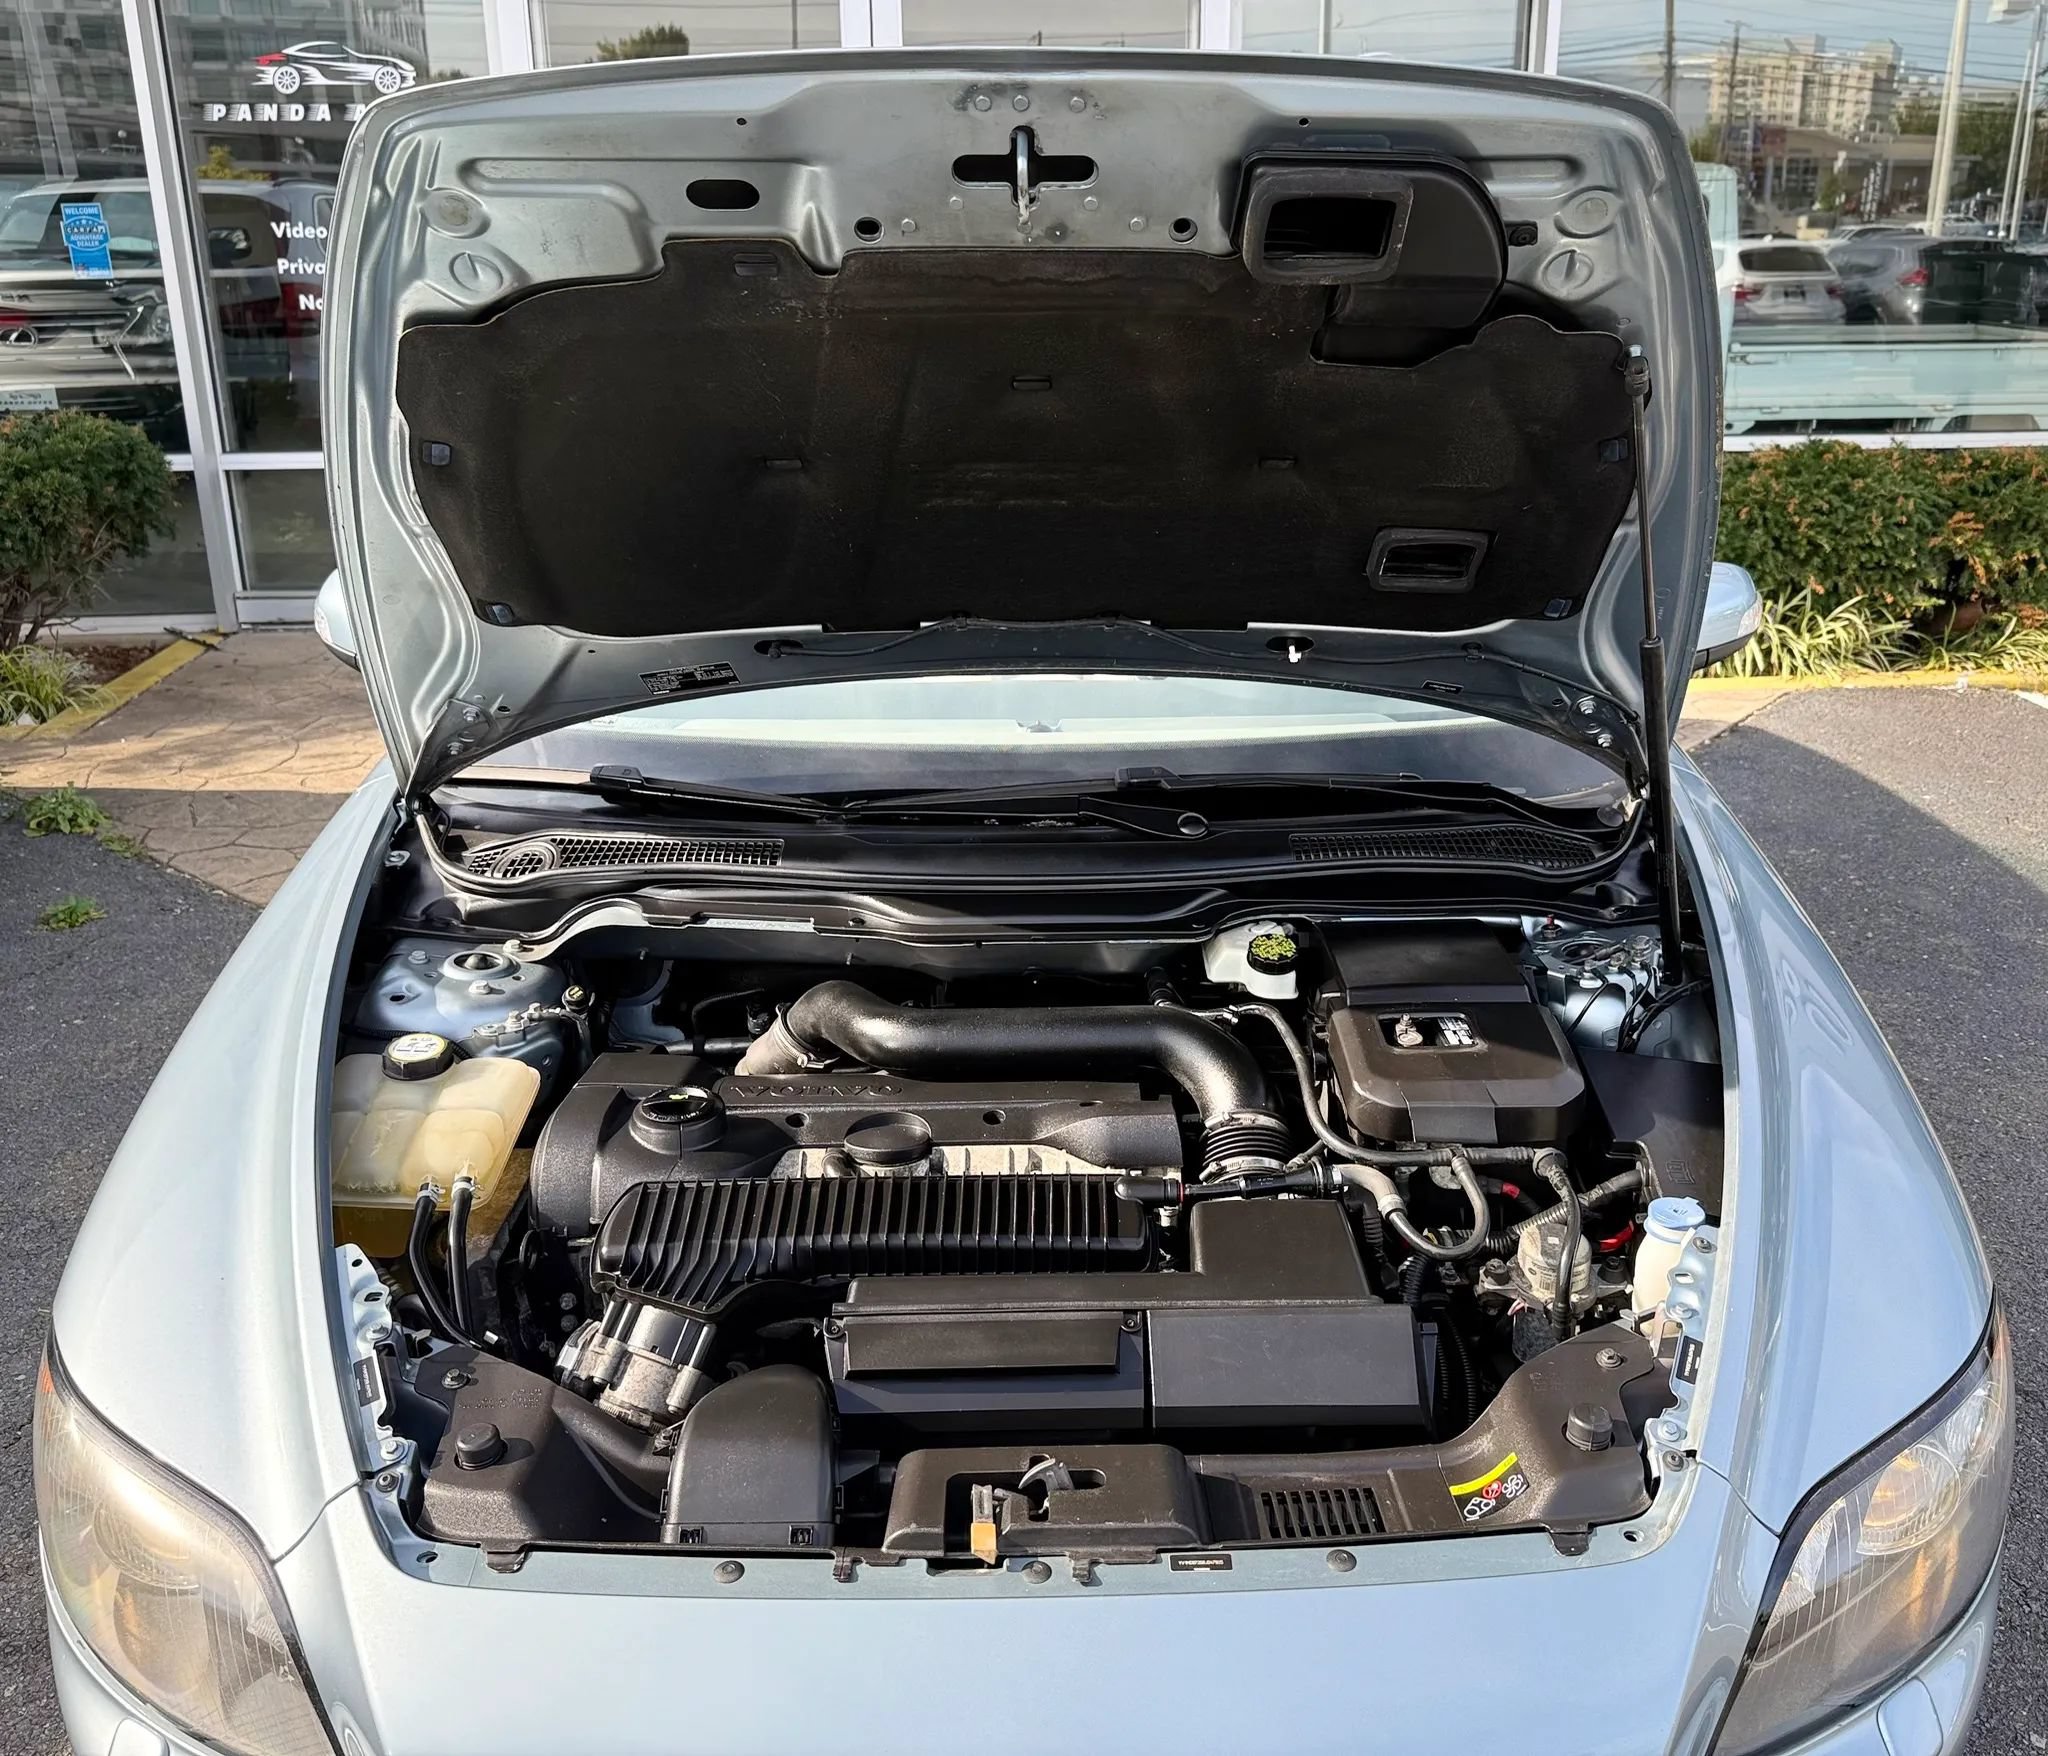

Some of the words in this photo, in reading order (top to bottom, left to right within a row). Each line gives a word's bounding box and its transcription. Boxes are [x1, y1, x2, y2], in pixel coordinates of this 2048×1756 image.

[203, 103, 332, 121] PANDA
[65, 207, 99, 215] WELCOME
[270, 221, 328, 239] Video
[730, 1085, 903, 1098] VOLVO
